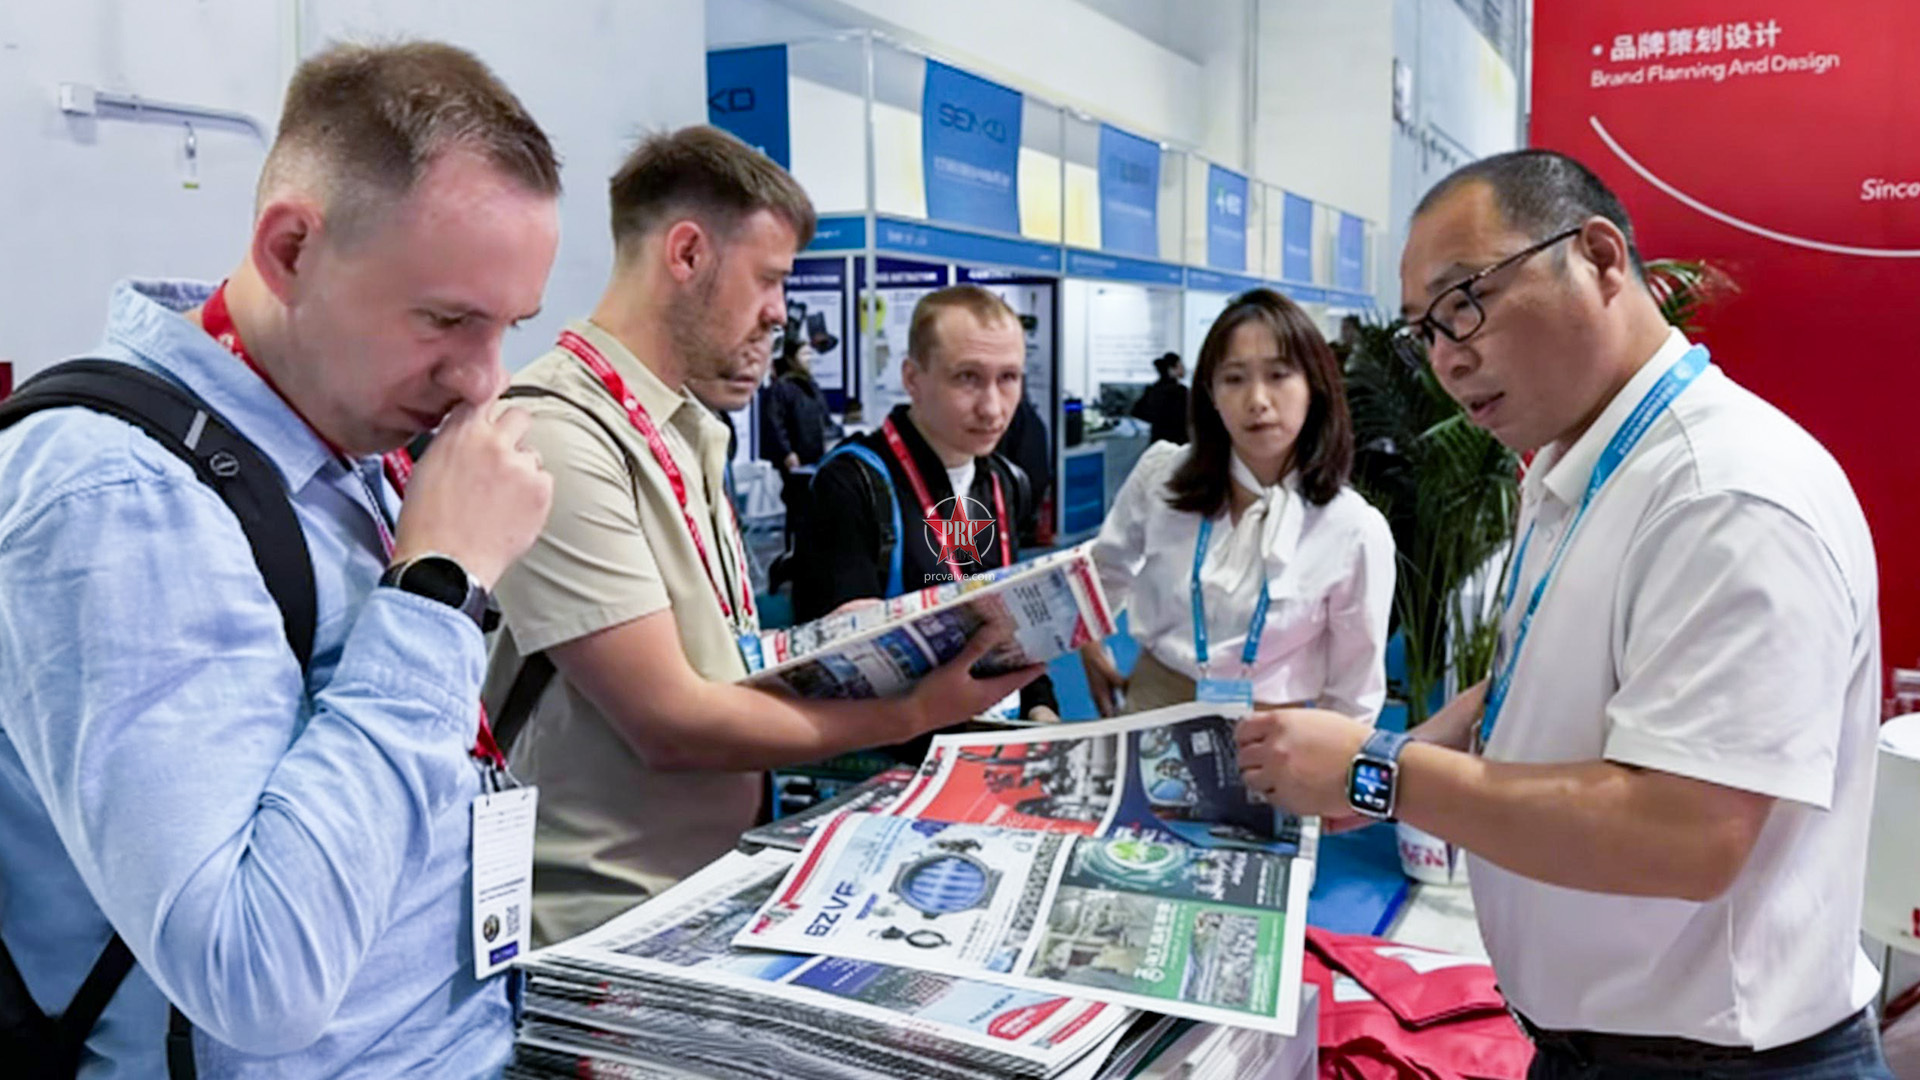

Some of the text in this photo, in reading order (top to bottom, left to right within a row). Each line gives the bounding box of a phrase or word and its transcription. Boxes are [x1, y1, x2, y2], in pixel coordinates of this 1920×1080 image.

[1610, 19, 1782, 62] 品牌策划设计
[1590, 51, 1841, 88] Brand Planning And Design
